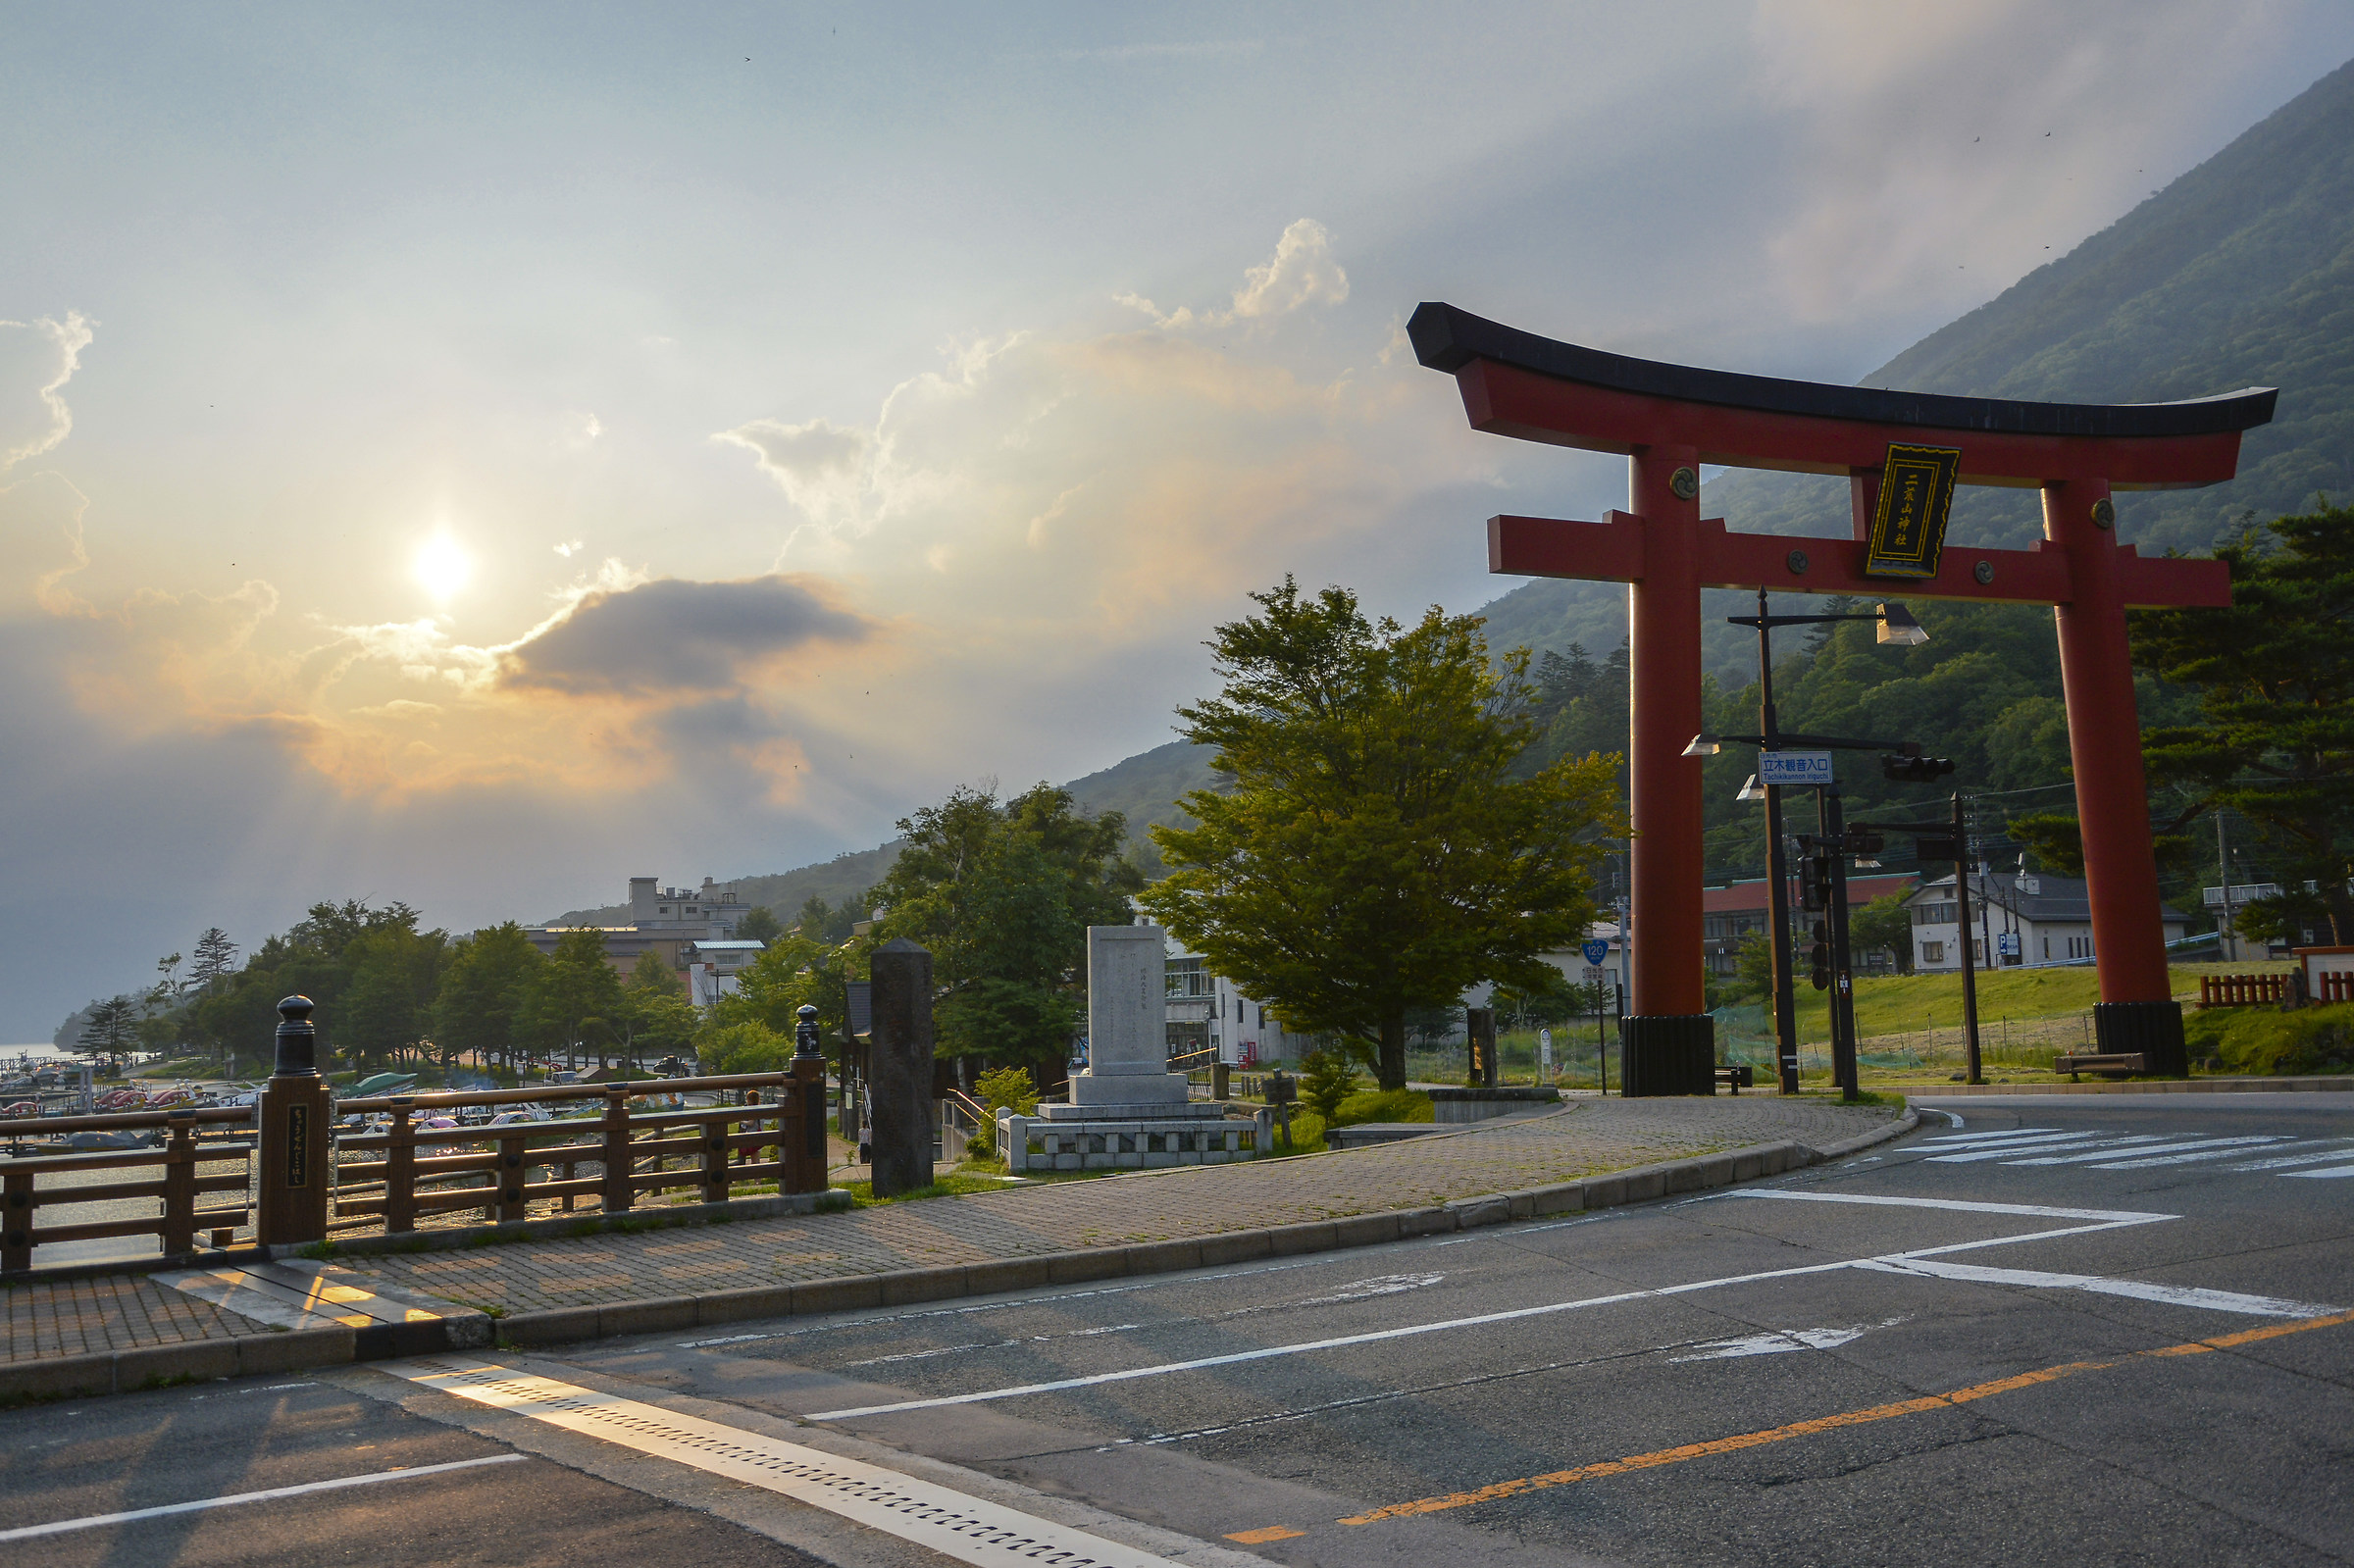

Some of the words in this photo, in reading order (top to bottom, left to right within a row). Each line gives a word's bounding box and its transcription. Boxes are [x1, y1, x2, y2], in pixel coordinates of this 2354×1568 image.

[1894, 475, 1919, 545] 二荒山神社
[1764, 759, 1828, 772] 立木観音入口
[2000, 936, 2005, 947] P
[1587, 945, 1604, 956] 120
